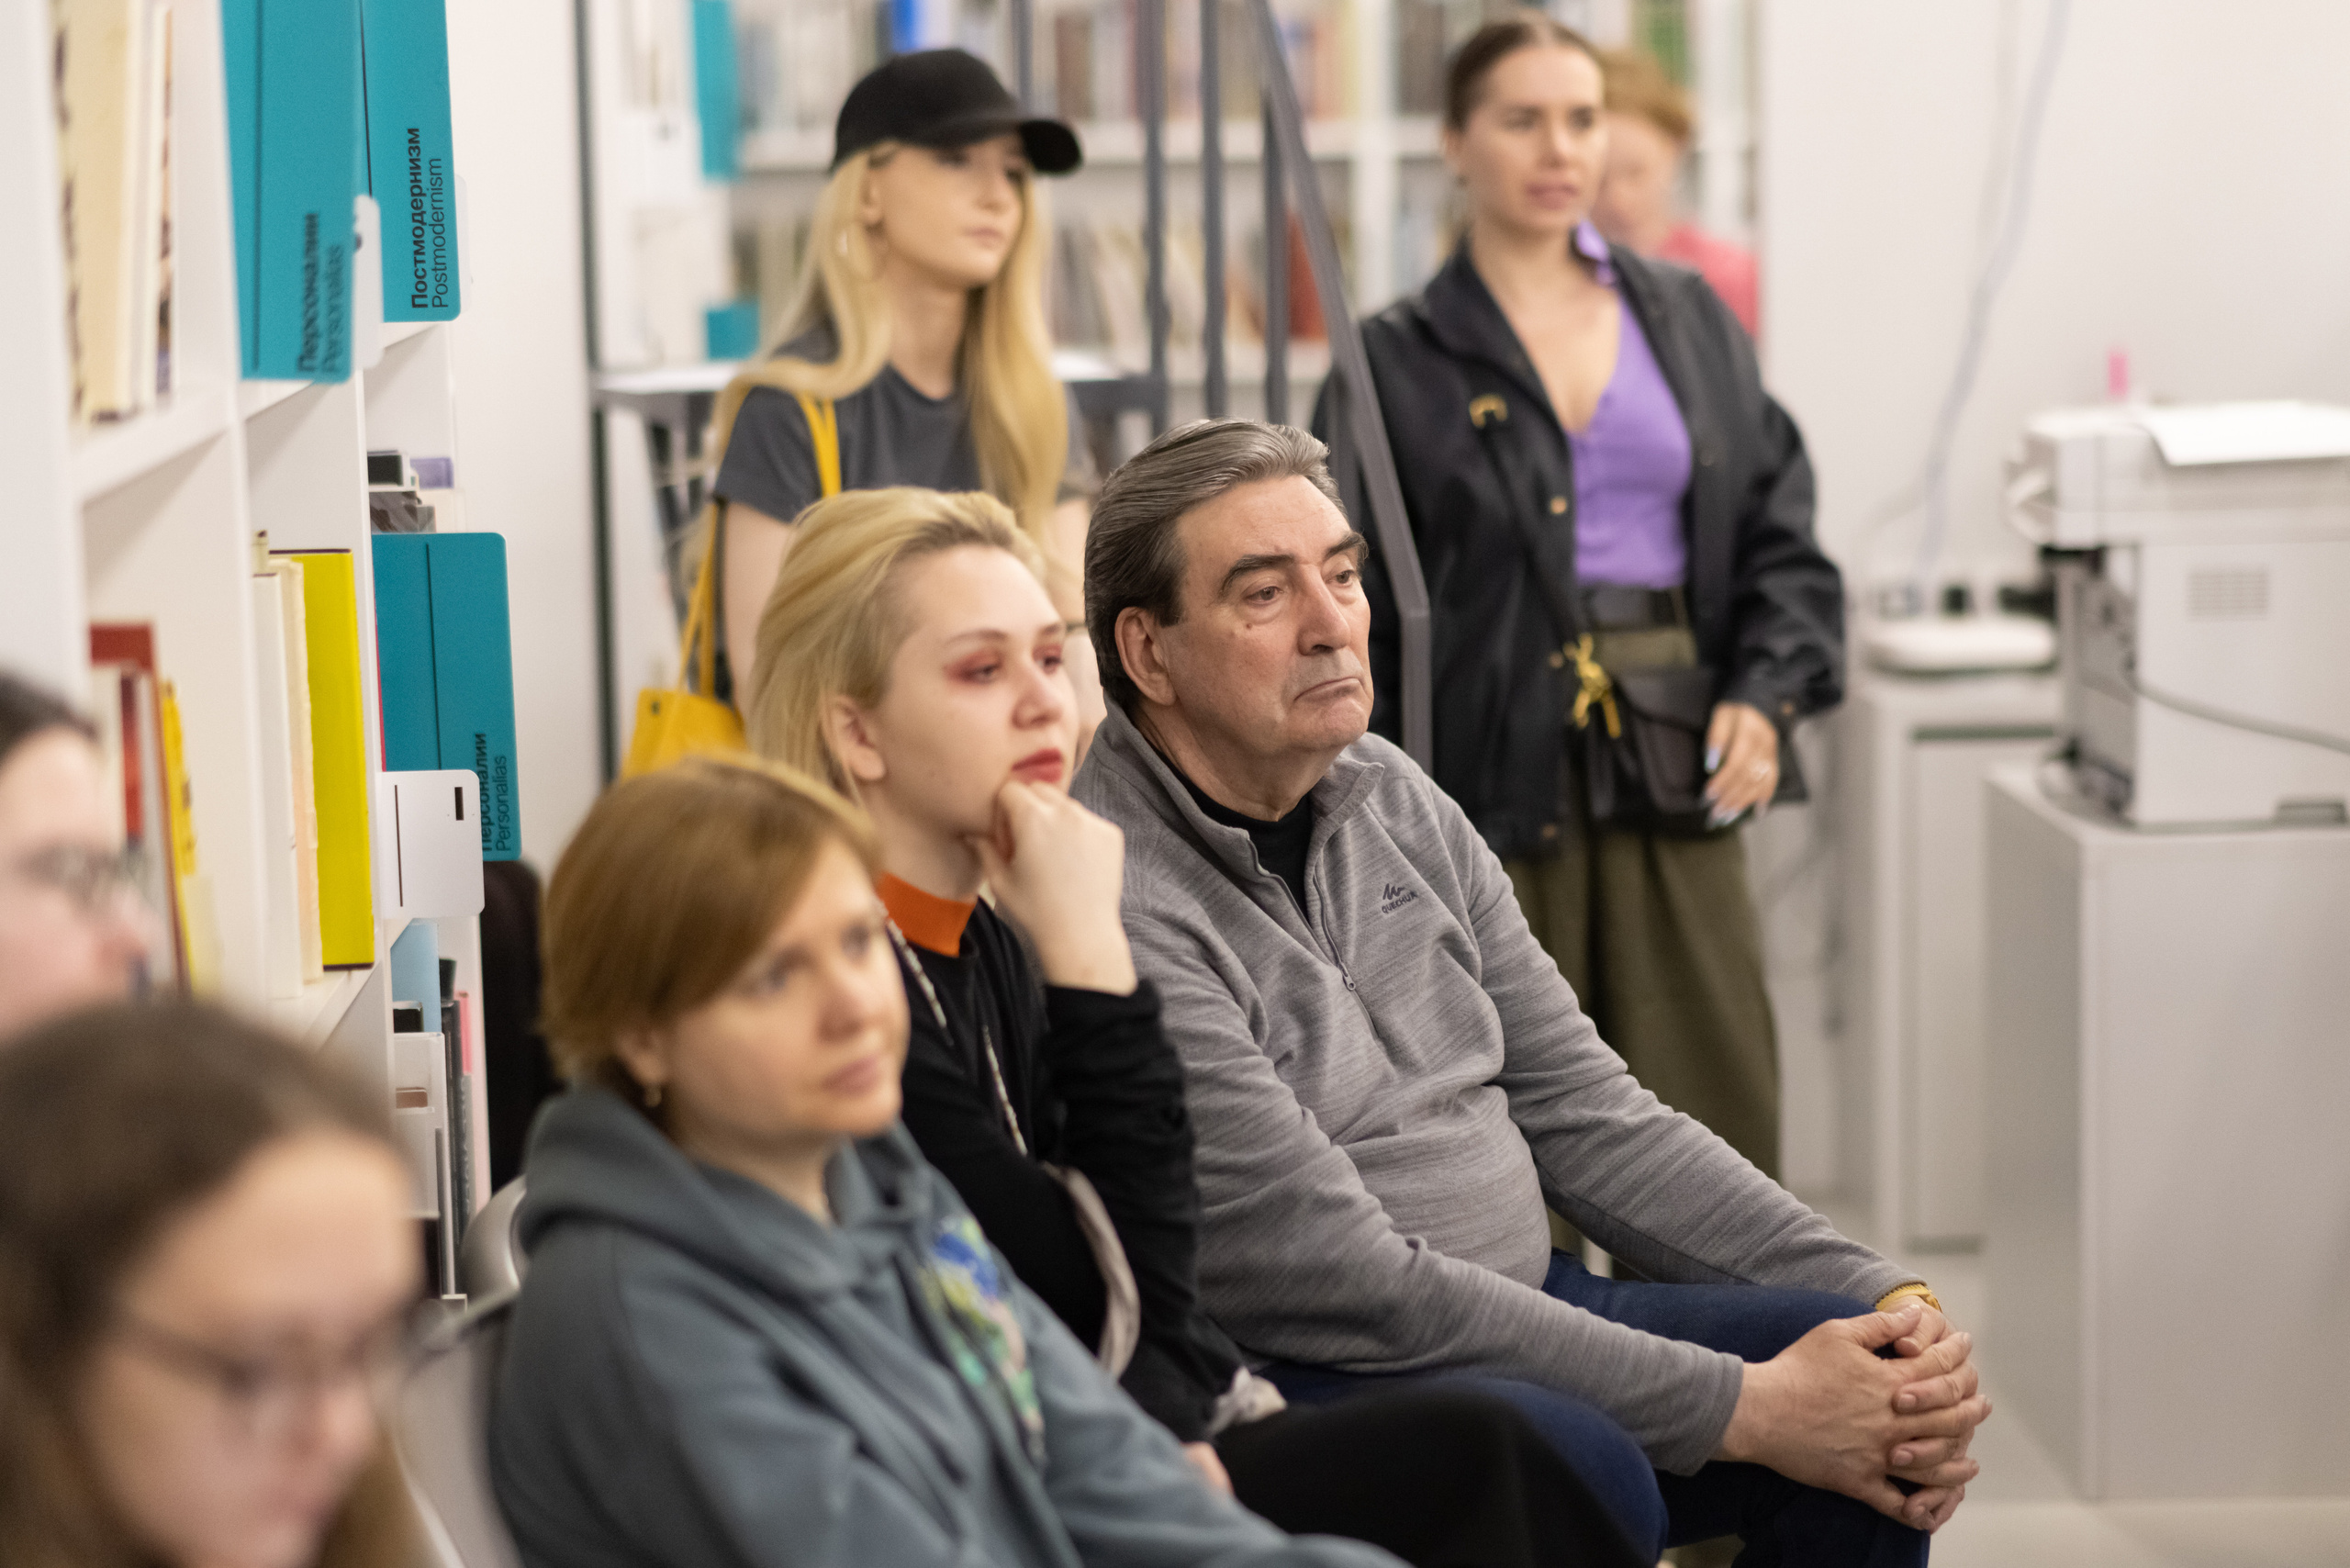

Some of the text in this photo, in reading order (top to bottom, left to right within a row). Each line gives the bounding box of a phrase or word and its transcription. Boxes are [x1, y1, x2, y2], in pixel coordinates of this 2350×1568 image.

[408, 129, 429, 308] Постмодернизм
[428, 158, 449, 308] Postmodernism
[492, 756, 511, 852] Personalias
